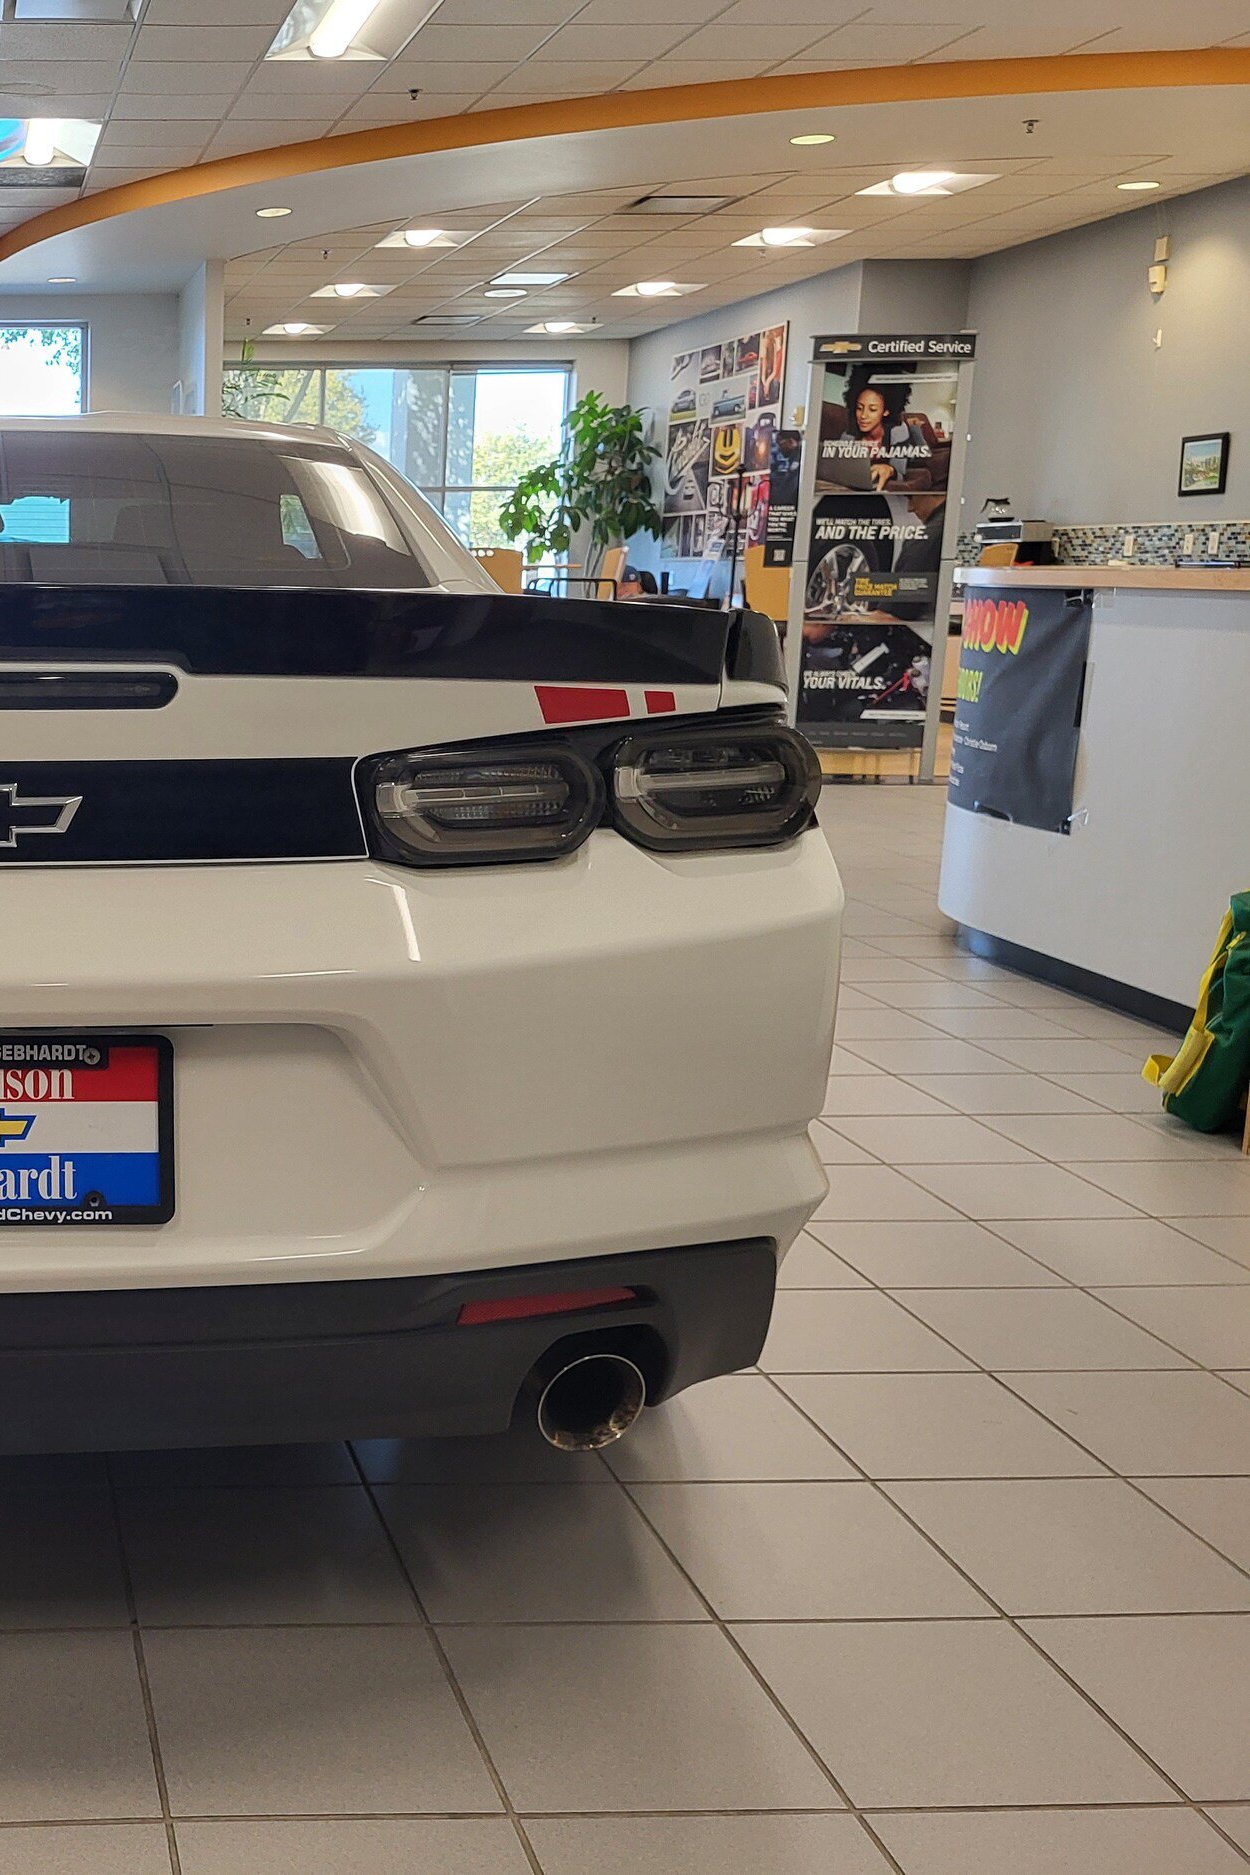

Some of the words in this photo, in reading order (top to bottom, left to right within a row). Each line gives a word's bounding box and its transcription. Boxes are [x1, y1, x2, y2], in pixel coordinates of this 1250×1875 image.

[868, 340, 924, 353] Certified
[928, 340, 972, 353] Service
[822, 446, 836, 458] IN
[838, 446, 869, 458] YOUR
[870, 445, 932, 458] PAJAMAS.
[815, 526, 845, 540] AND
[849, 526, 879, 539] THE
[879, 525, 929, 540] PRICE.
[803, 676, 836, 689] YOUR
[837, 676, 887, 690] VITALS.
